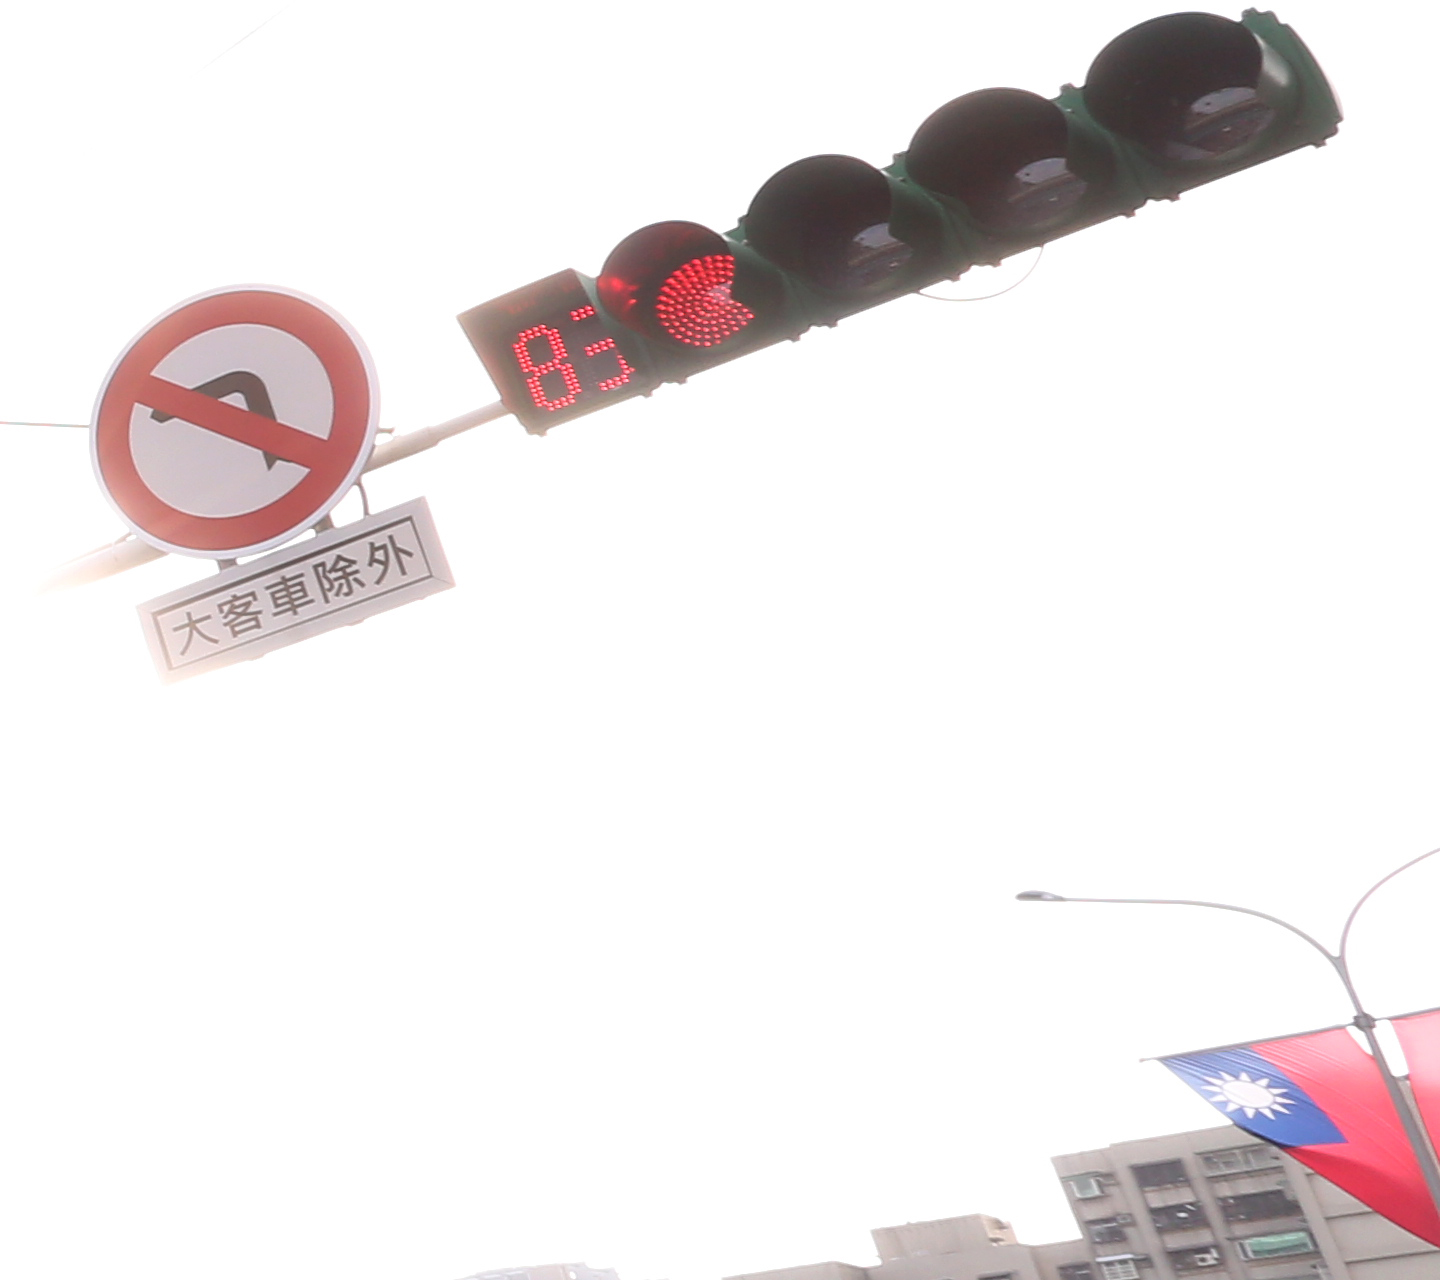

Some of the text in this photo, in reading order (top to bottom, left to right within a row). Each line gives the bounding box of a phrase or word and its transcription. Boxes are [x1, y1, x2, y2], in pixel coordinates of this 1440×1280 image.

[171, 532, 415, 657] 大客車除外
